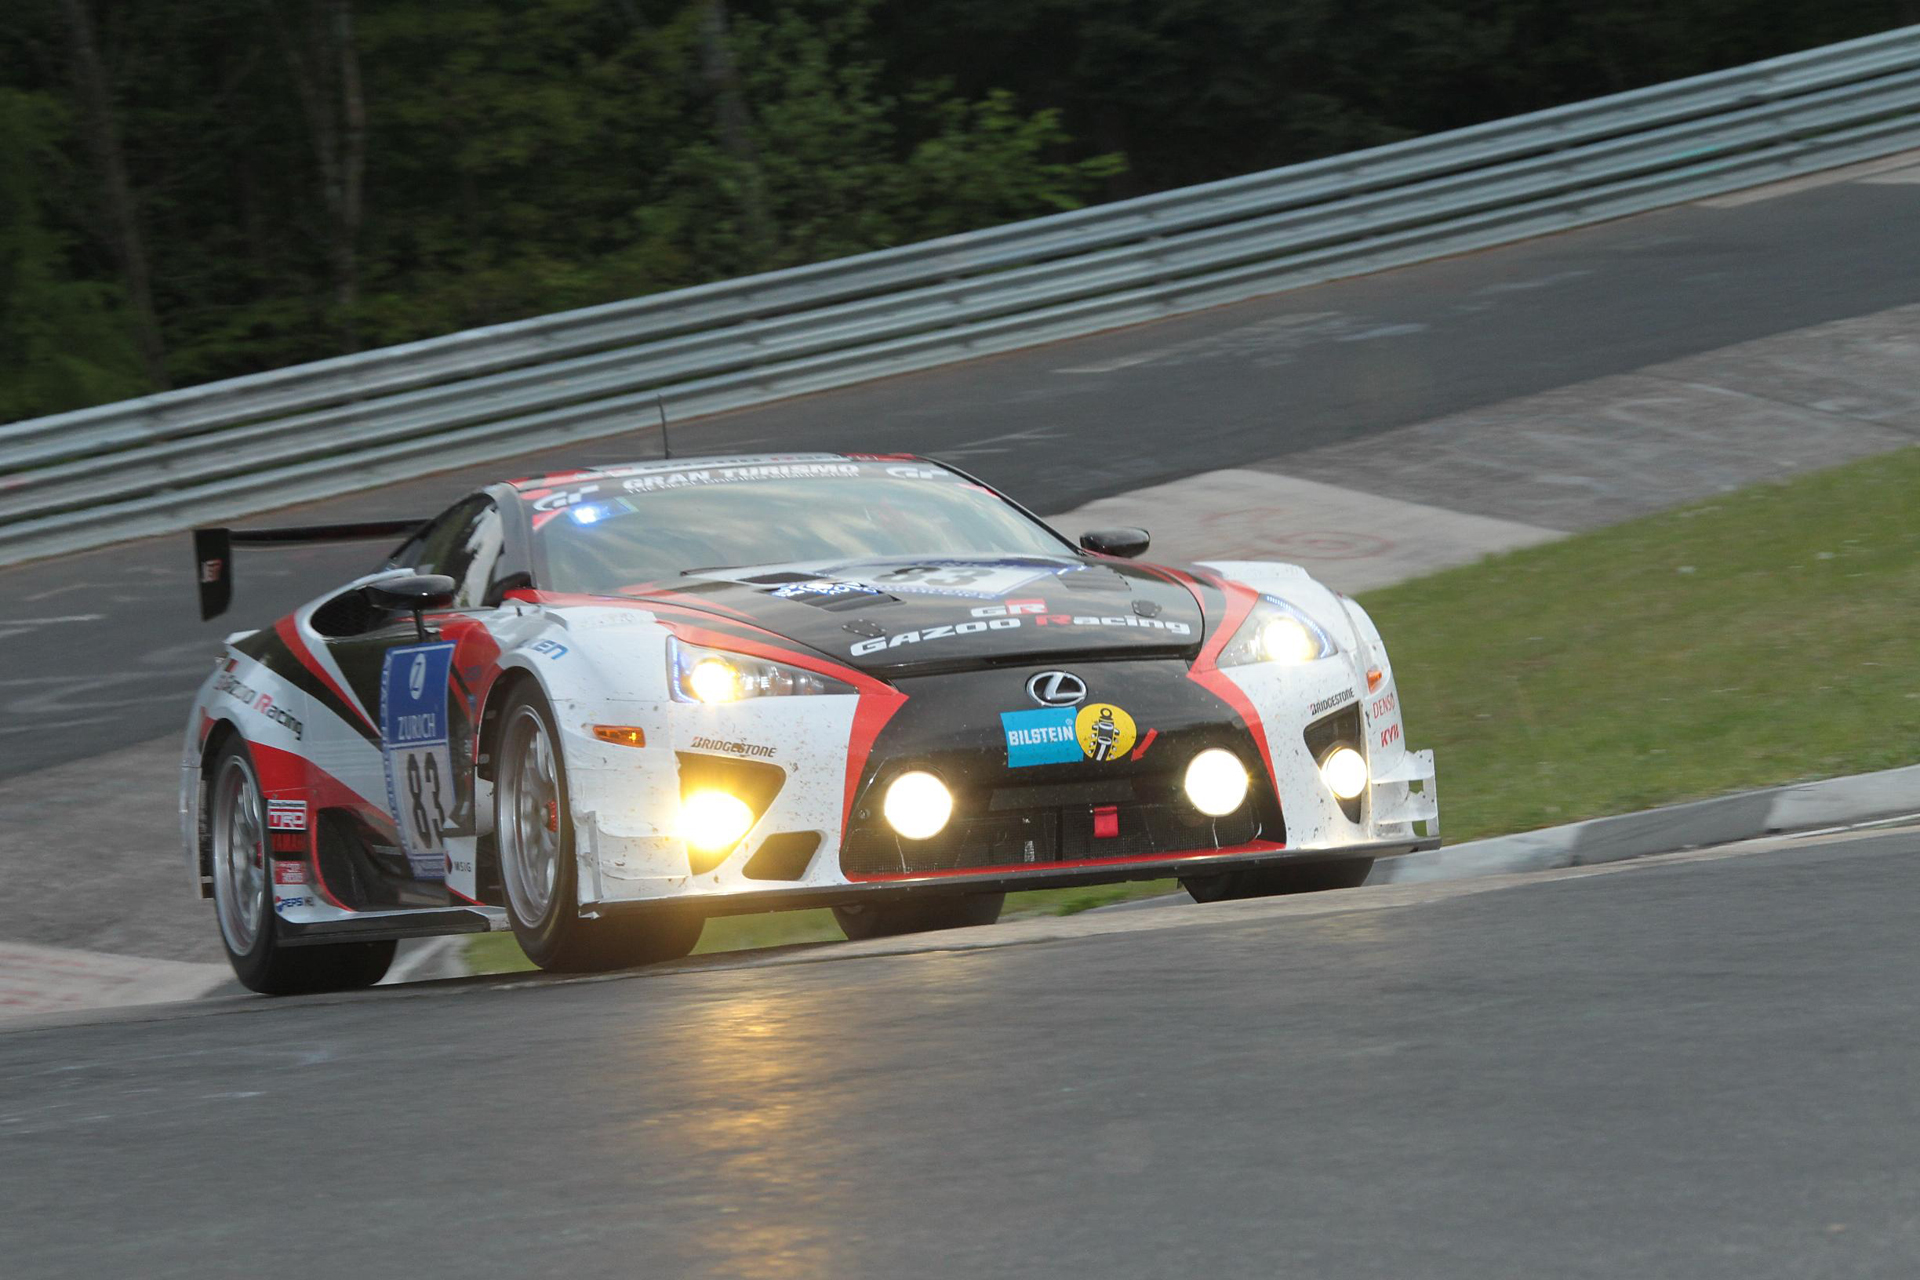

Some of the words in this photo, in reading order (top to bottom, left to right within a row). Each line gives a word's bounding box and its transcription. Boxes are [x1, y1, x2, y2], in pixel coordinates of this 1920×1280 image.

[622, 471, 711, 490] GRAN
[719, 463, 860, 479] TURISMO
[873, 566, 994, 586] 83
[970, 602, 1047, 618] GR
[850, 618, 1021, 657] GAZOO
[1035, 614, 1191, 635] Racing
[1309, 687, 1355, 716] BRIDGESTONE
[1372, 692, 1396, 719] DENSO
[253, 692, 303, 741] Racing
[397, 712, 437, 741] ZURICH
[690, 736, 777, 758] BRIDGESTONE
[1008, 725, 1074, 746] BILSTEIN
[407, 752, 446, 850] 83
[269, 811, 306, 829] TRD
